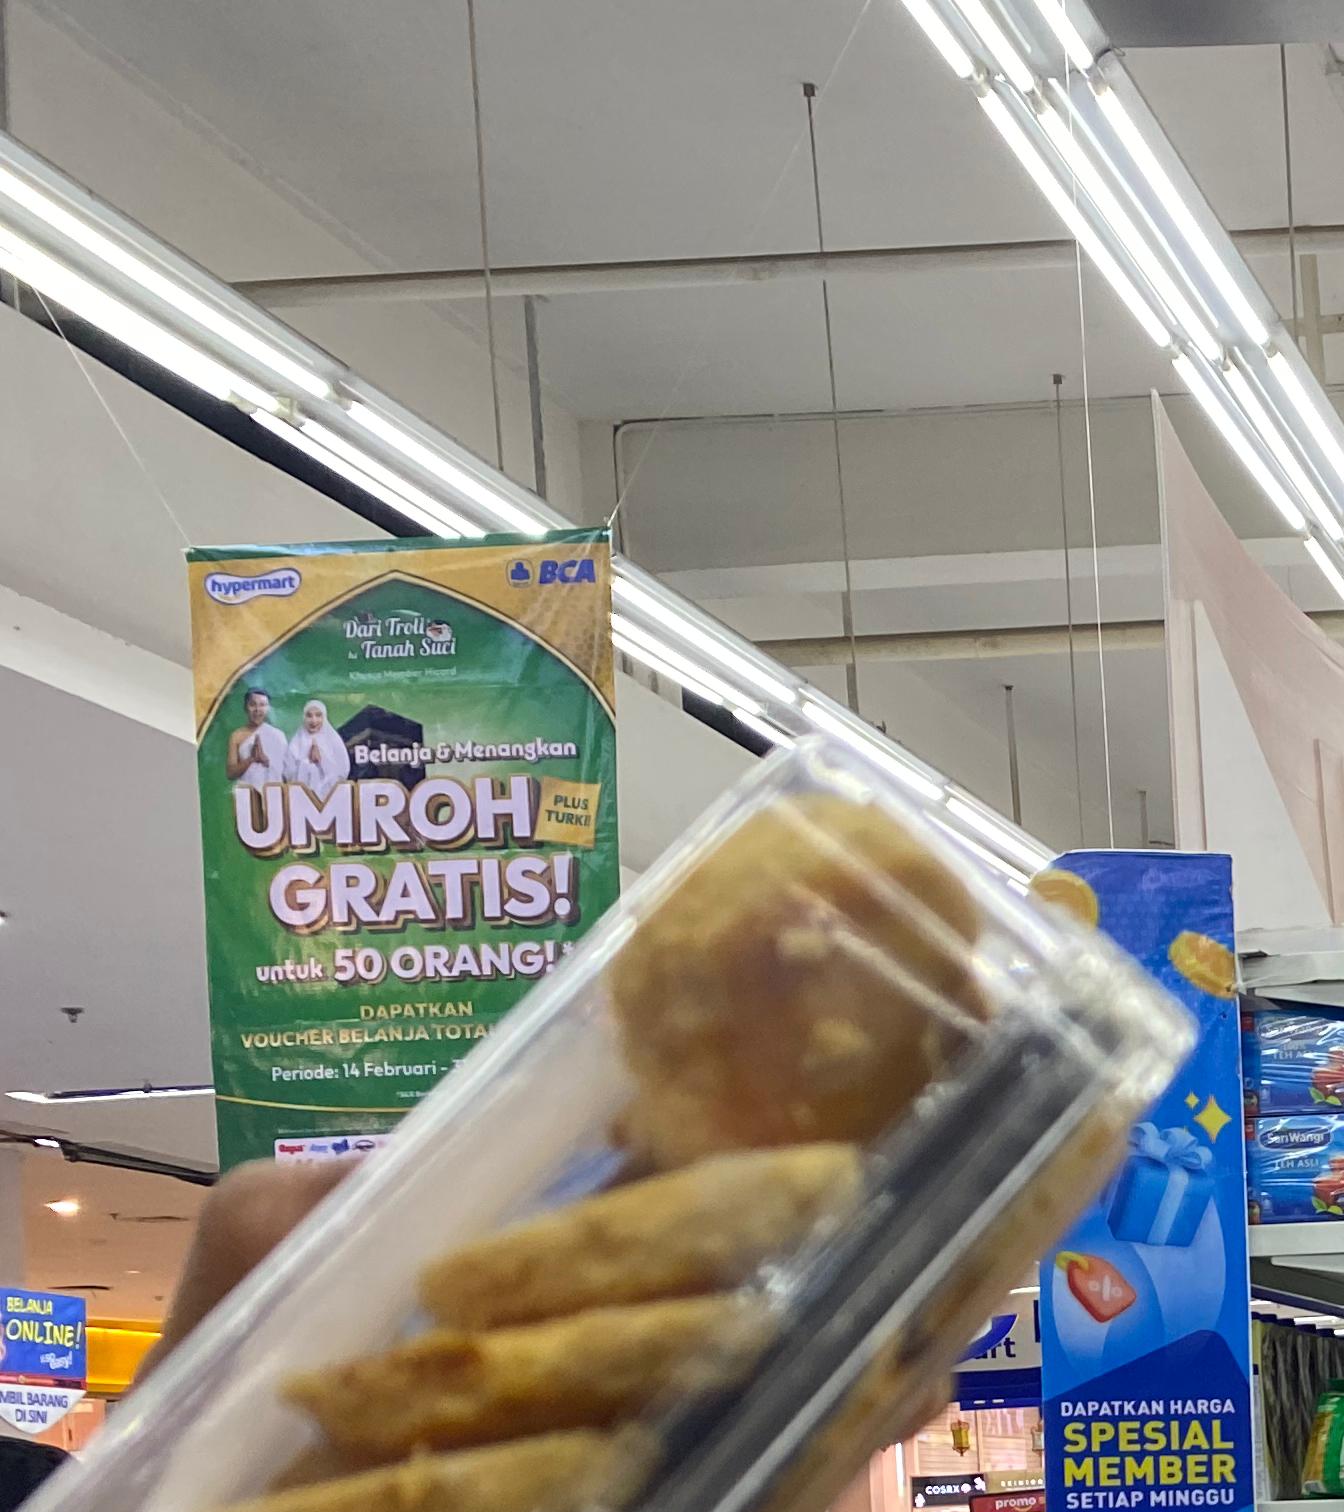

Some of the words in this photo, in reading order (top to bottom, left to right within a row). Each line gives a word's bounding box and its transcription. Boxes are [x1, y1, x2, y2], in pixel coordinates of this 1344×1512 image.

[538, 560, 597, 584] BCA
[210, 575, 295, 596] hypermart
[344, 618, 382, 639] Dari
[386, 617, 425, 637] Troli
[361, 641, 415, 659] Tanah
[420, 638, 456, 656] Suci
[355, 742, 432, 767] Belanja
[436, 745, 450, 761] &
[454, 738, 577, 762] Menangkan
[234, 775, 532, 850] UMROH
[553, 794, 589, 811] PLUS
[270, 854, 574, 927] GRATIS!
[256, 960, 323, 984] untuk
[334, 949, 385, 982] 50
[360, 1001, 473, 1021] DAPATKAN
[241, 1026, 333, 1049] VOUCHER
[339, 1024, 430, 1045] BELANJA
[432, 1022, 495, 1041] TOTA
[272, 1065, 340, 1082] Periode:
[343, 1063, 360, 1079] 14
[364, 1060, 437, 1078] Februari
[1267, 1126, 1325, 1146] SariWangi
[1297, 1157, 1319, 1169] ASLI
[7, 1296, 53, 1314] BELANJA
[6, 1318, 82, 1349] ONLINE!
[27, 1391, 68, 1409] BARANG
[1061, 1400, 1164, 1417] DAPATKAN
[1170, 1398, 1236, 1415] HARGA
[16, 1409, 26, 1422] DI
[28, 1410, 47, 1424] SINI
[1063, 1419, 1235, 1453] SPESIAL
[1063, 1454, 1237, 1488] MEMBER
[995, 1496, 1037, 1510] promo
[1066, 1490, 1144, 1509] SETIAP
[1150, 1488, 1235, 1508] MINGGU
